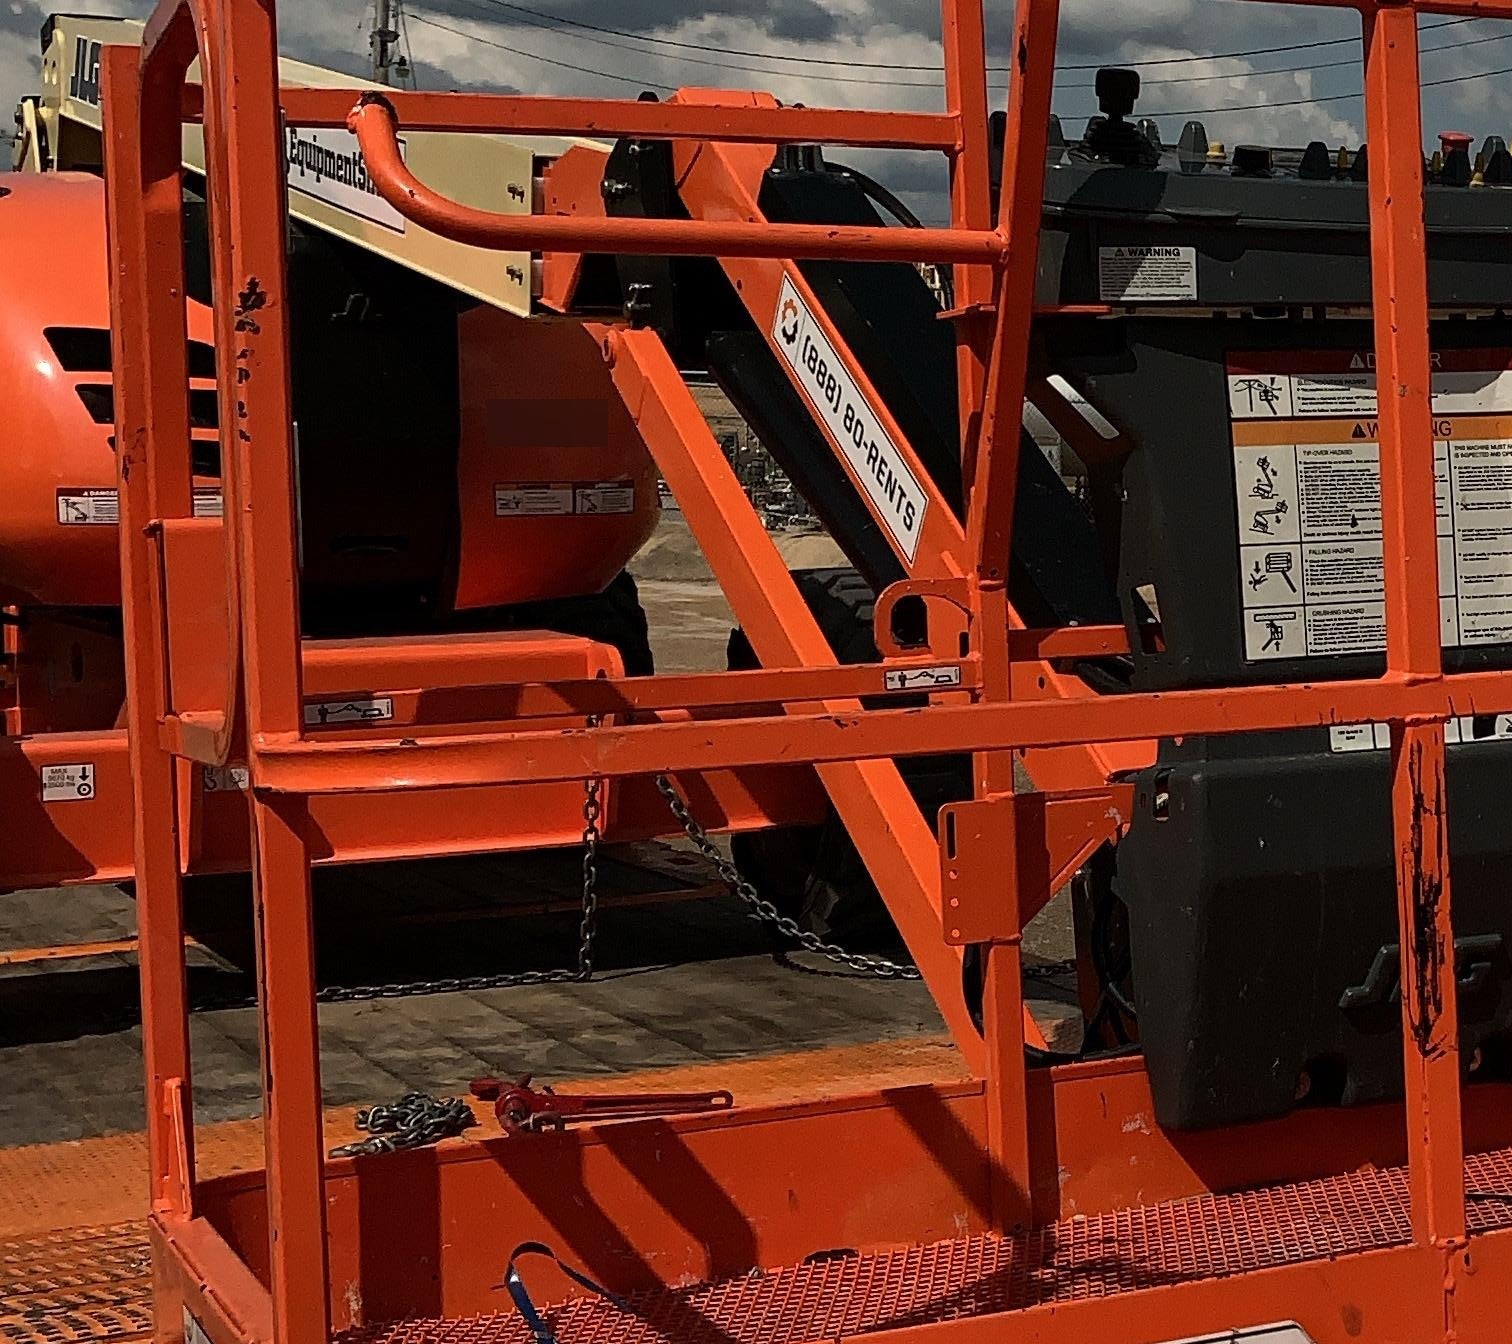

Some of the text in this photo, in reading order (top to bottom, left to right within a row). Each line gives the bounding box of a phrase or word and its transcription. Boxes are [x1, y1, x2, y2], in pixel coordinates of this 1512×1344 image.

[289, 127, 382, 197] EquipmentS
[1127, 247, 1181, 257] WARNING
[801, 334, 916, 533] (888) 80-RENTS
